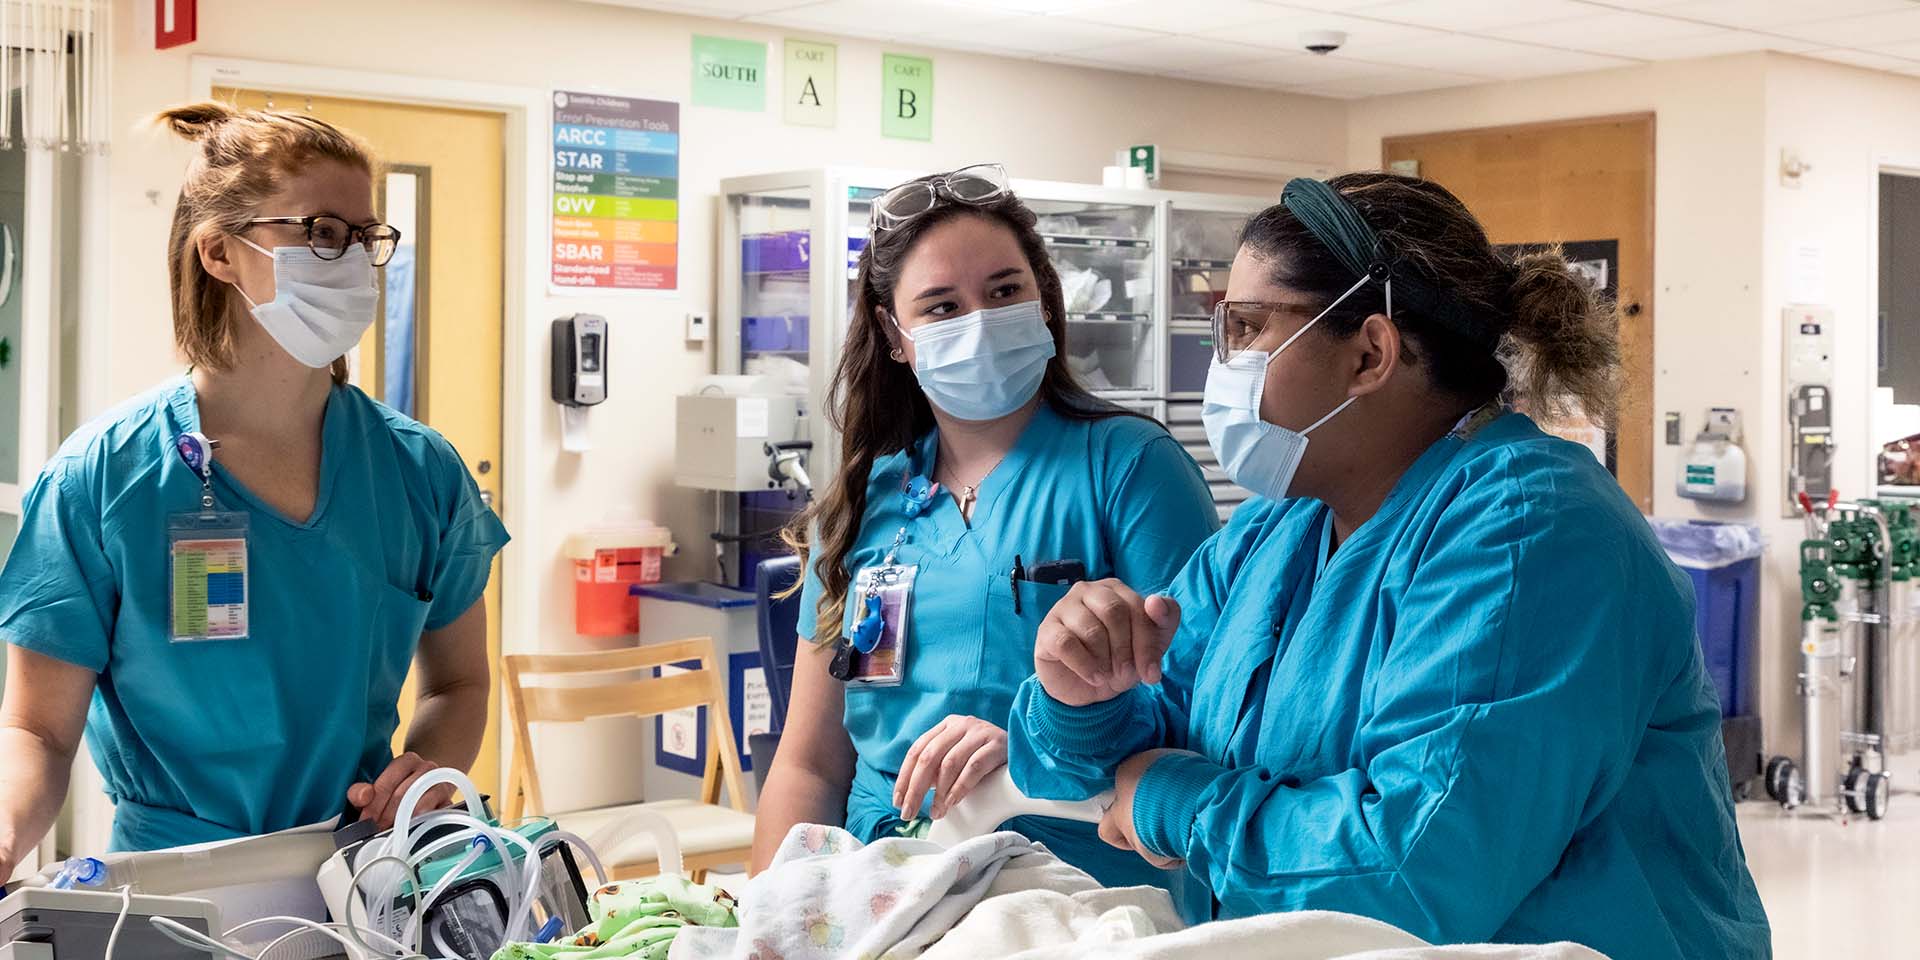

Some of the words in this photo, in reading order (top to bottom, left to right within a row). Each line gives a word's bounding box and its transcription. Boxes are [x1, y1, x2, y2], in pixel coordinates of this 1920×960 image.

[795, 49, 825, 63] CART
[703, 63, 757, 83] SOUTH
[894, 63, 921, 77] CART
[798, 75, 821, 106] A
[898, 88, 917, 119] B
[555, 112, 583, 123] Error
[585, 114, 640, 129] Prevention
[641, 119, 670, 131] Tools
[556, 128, 607, 146] ARCC
[556, 150, 604, 169] STAR
[555, 171, 576, 183] Stop
[577, 173, 594, 183] and
[555, 182, 589, 193] Resolve
[556, 196, 596, 213] QVV
[555, 243, 603, 260] SBAR
[554, 264, 611, 275] Standardized
